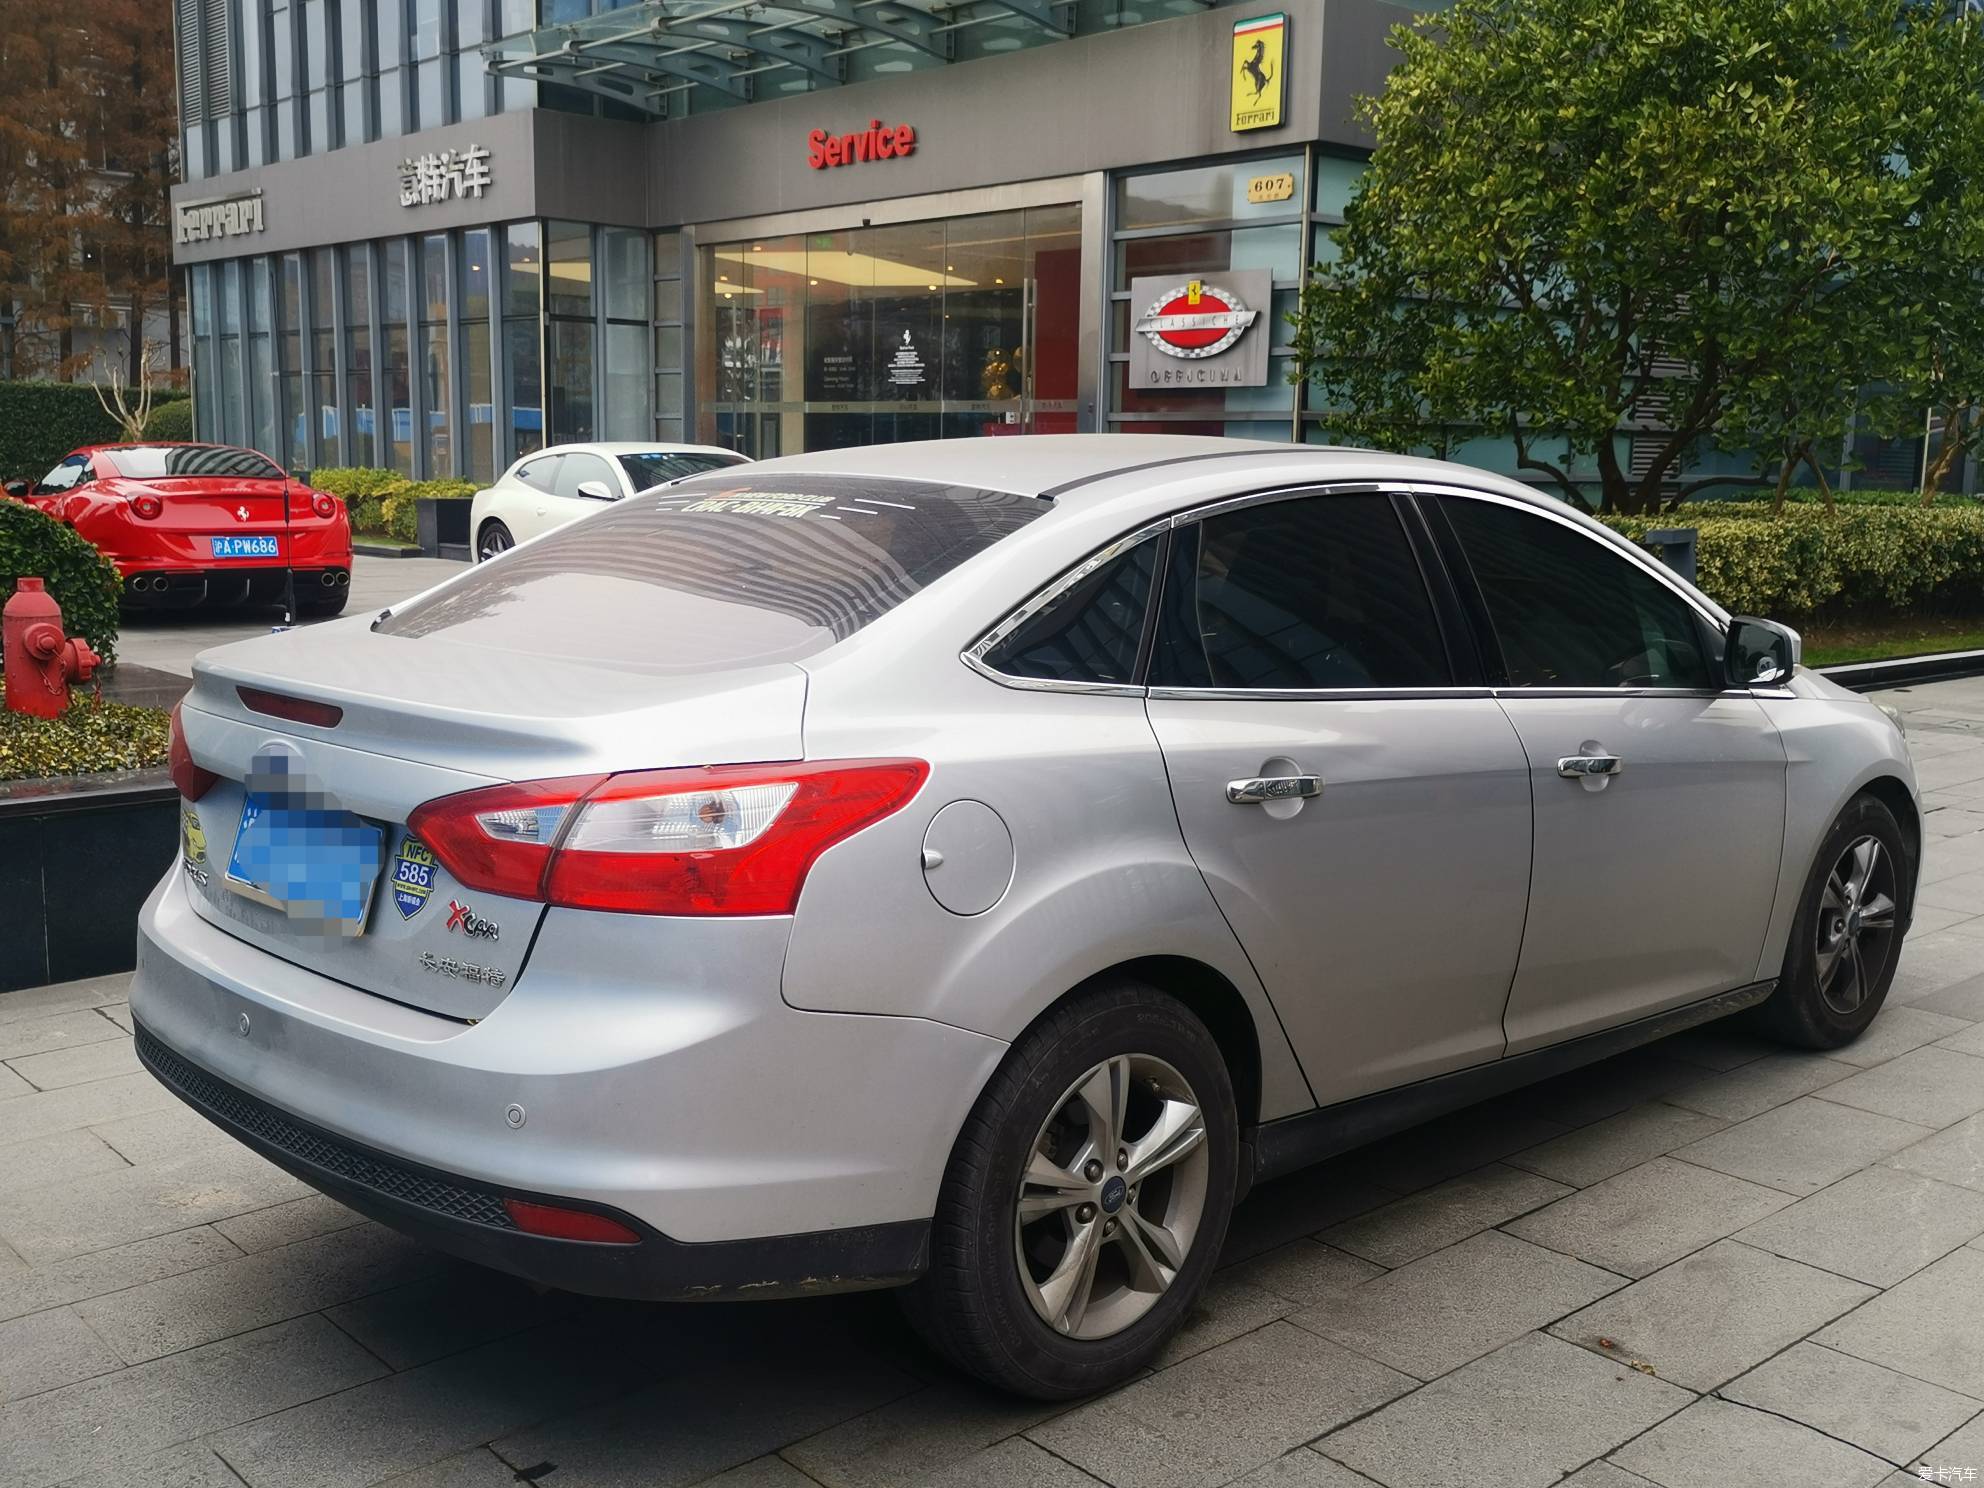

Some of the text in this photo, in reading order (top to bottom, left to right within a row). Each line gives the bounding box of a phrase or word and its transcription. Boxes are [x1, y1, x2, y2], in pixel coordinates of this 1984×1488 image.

[1235, 107, 1276, 127] Ferrari
[807, 118, 915, 170] Service
[1254, 178, 1285, 193] 607
[175, 186, 265, 244] Ferrari
[1150, 367, 1243, 384] OFFICINA
[406, 842, 430, 862] NFC
[399, 861, 430, 886] 585
[418, 951, 507, 988] 长安福特
